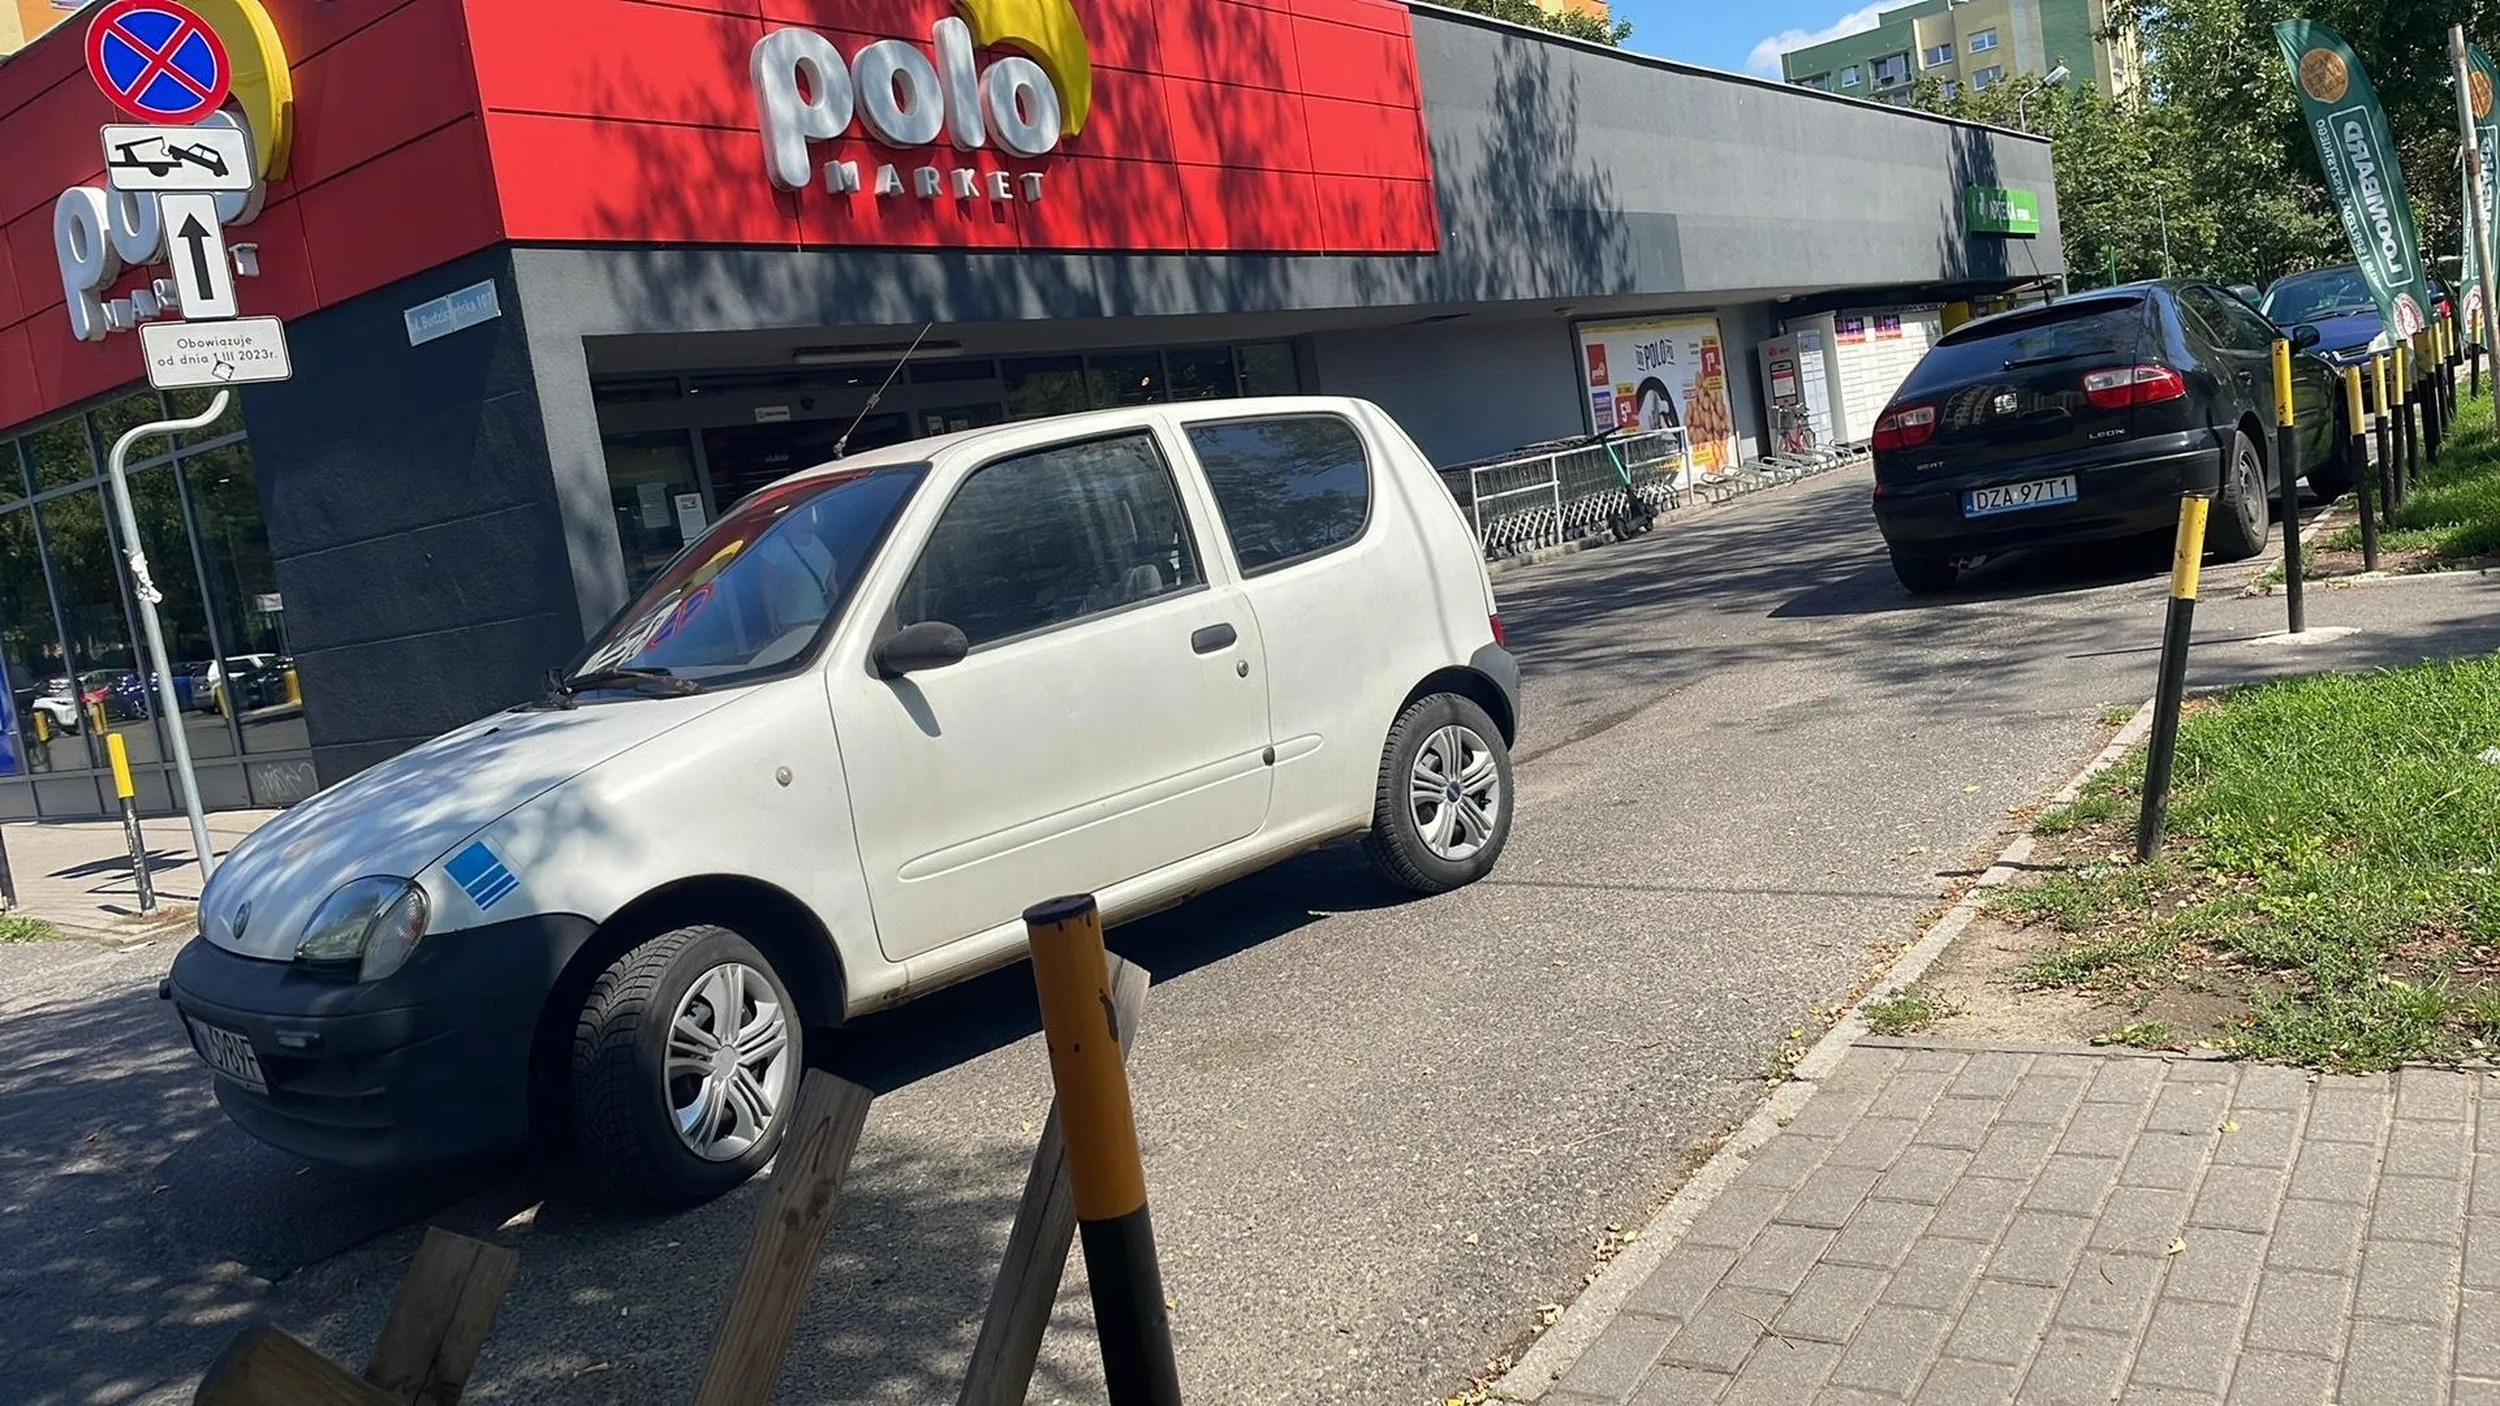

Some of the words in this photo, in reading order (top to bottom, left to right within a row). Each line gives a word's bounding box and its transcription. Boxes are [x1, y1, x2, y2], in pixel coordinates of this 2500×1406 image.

[750, 16, 1061, 192] polo
[822, 160, 1045, 203] MARKET
[101, 243, 262, 334] MART
[157, 355, 174, 366] od
[180, 353, 209, 365] dnia
[239, 349, 278, 361] 2023r.
[1644, 339, 1667, 370] POLO
[2088, 427, 2126, 440] LEON
[1916, 460, 1945, 471] SEAT
[1976, 487, 2014, 509] DZA
[2020, 478, 2069, 503] 97T1
